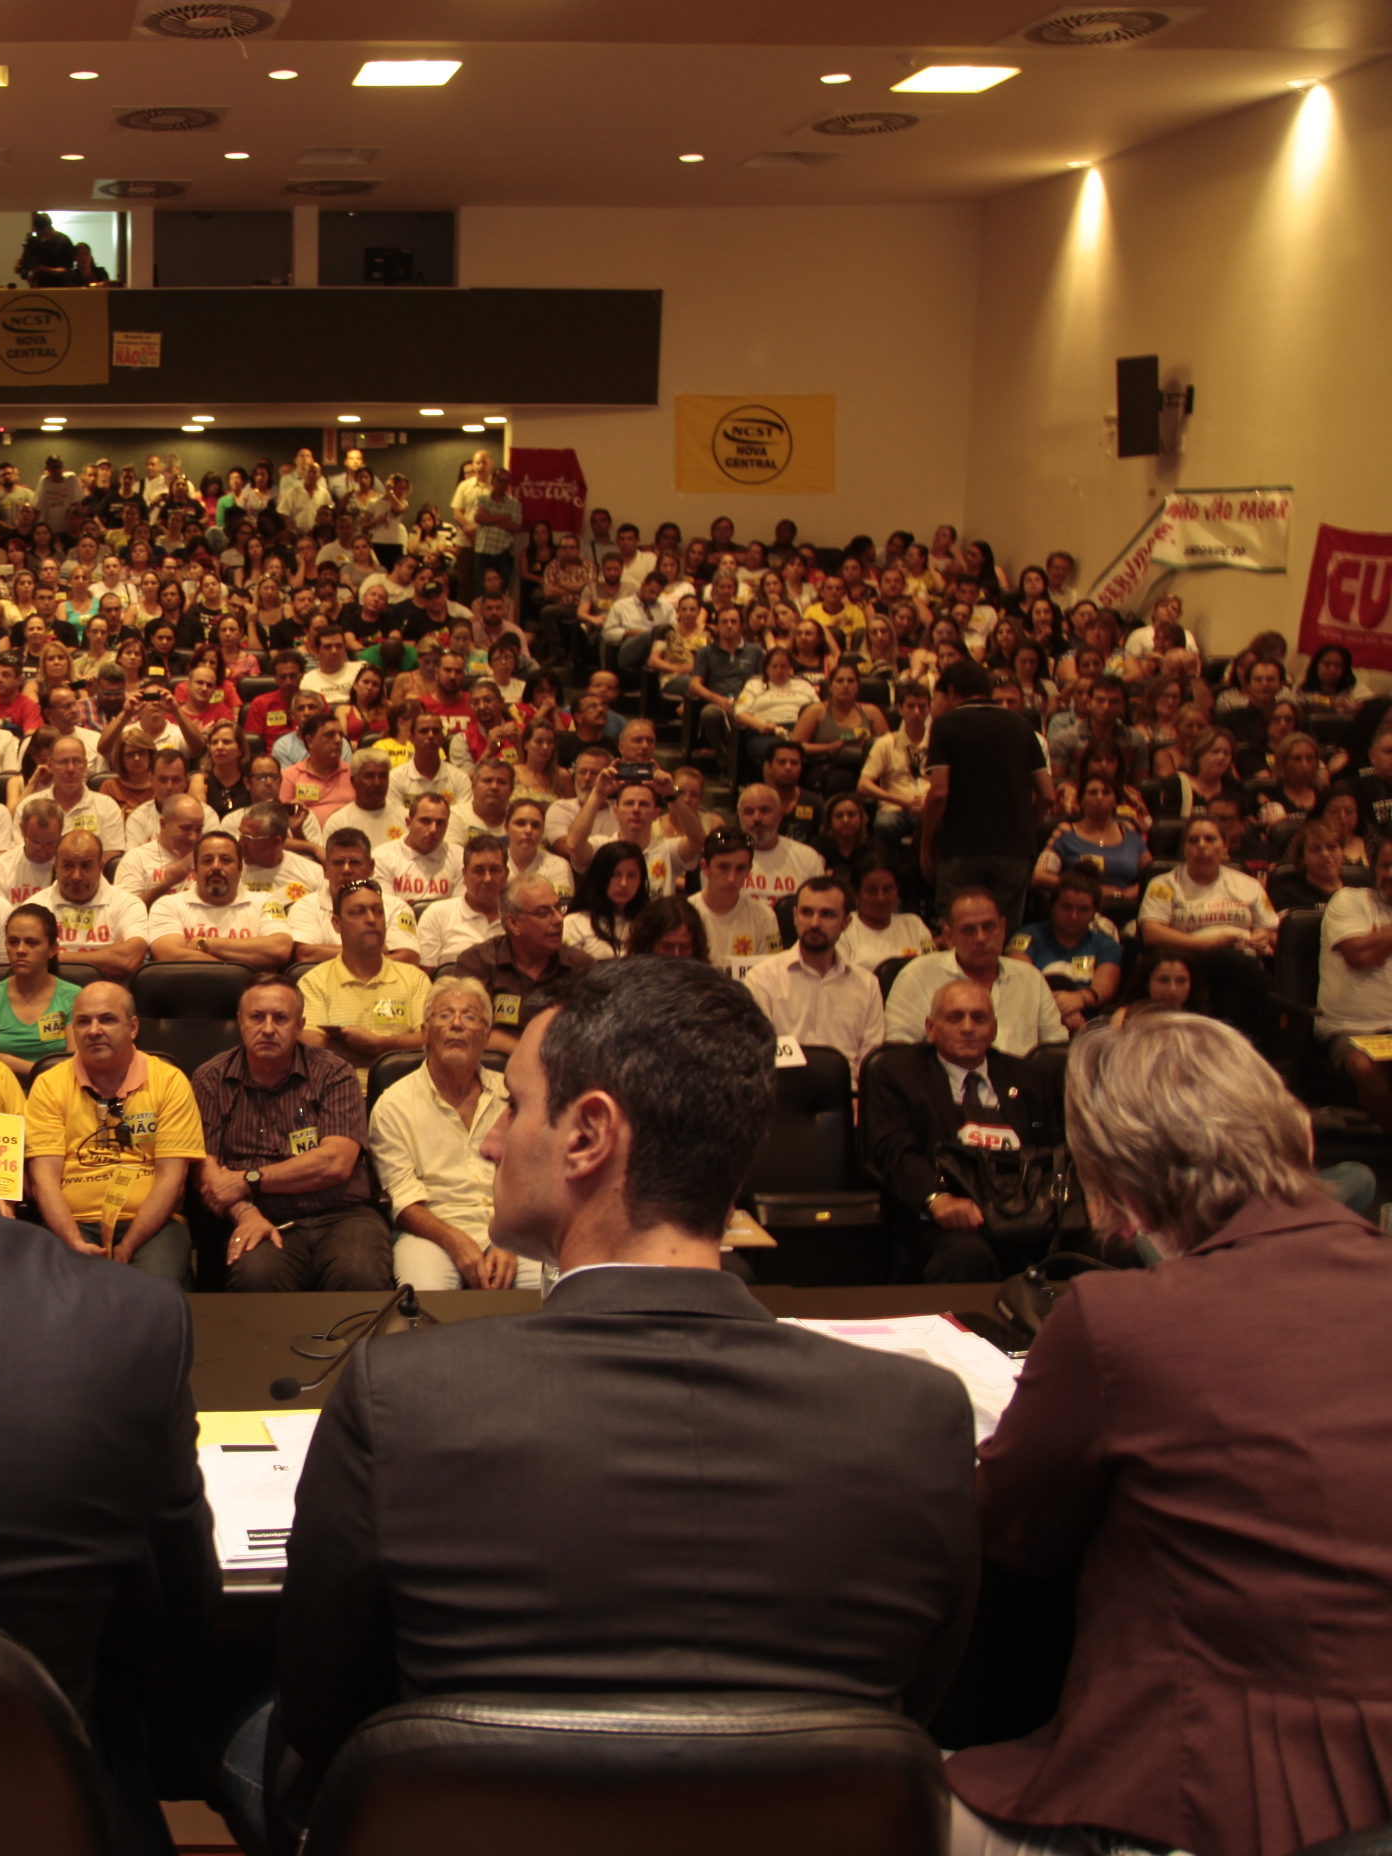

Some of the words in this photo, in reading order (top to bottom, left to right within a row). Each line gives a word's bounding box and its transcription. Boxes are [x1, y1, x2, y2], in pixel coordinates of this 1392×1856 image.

[10, 314, 54, 326] NCST
[16, 335, 48, 346] NOVA
[7, 346, 59, 359] CENTRAL
[731, 425, 774, 437] NCST
[736, 446, 768, 457] NOVA
[725, 456, 778, 470] CENTRAL
[1165, 497, 1199, 520] NÃO
[1204, 496, 1233, 521] VÃO
[1238, 499, 1289, 520] PAGAR
[394, 875, 424, 895] NÃO
[429, 878, 450, 895] AO
[774, 876, 795, 891] AO
[86, 926, 110, 943] AO
[249, 1531, 292, 1539] Florianópoli
